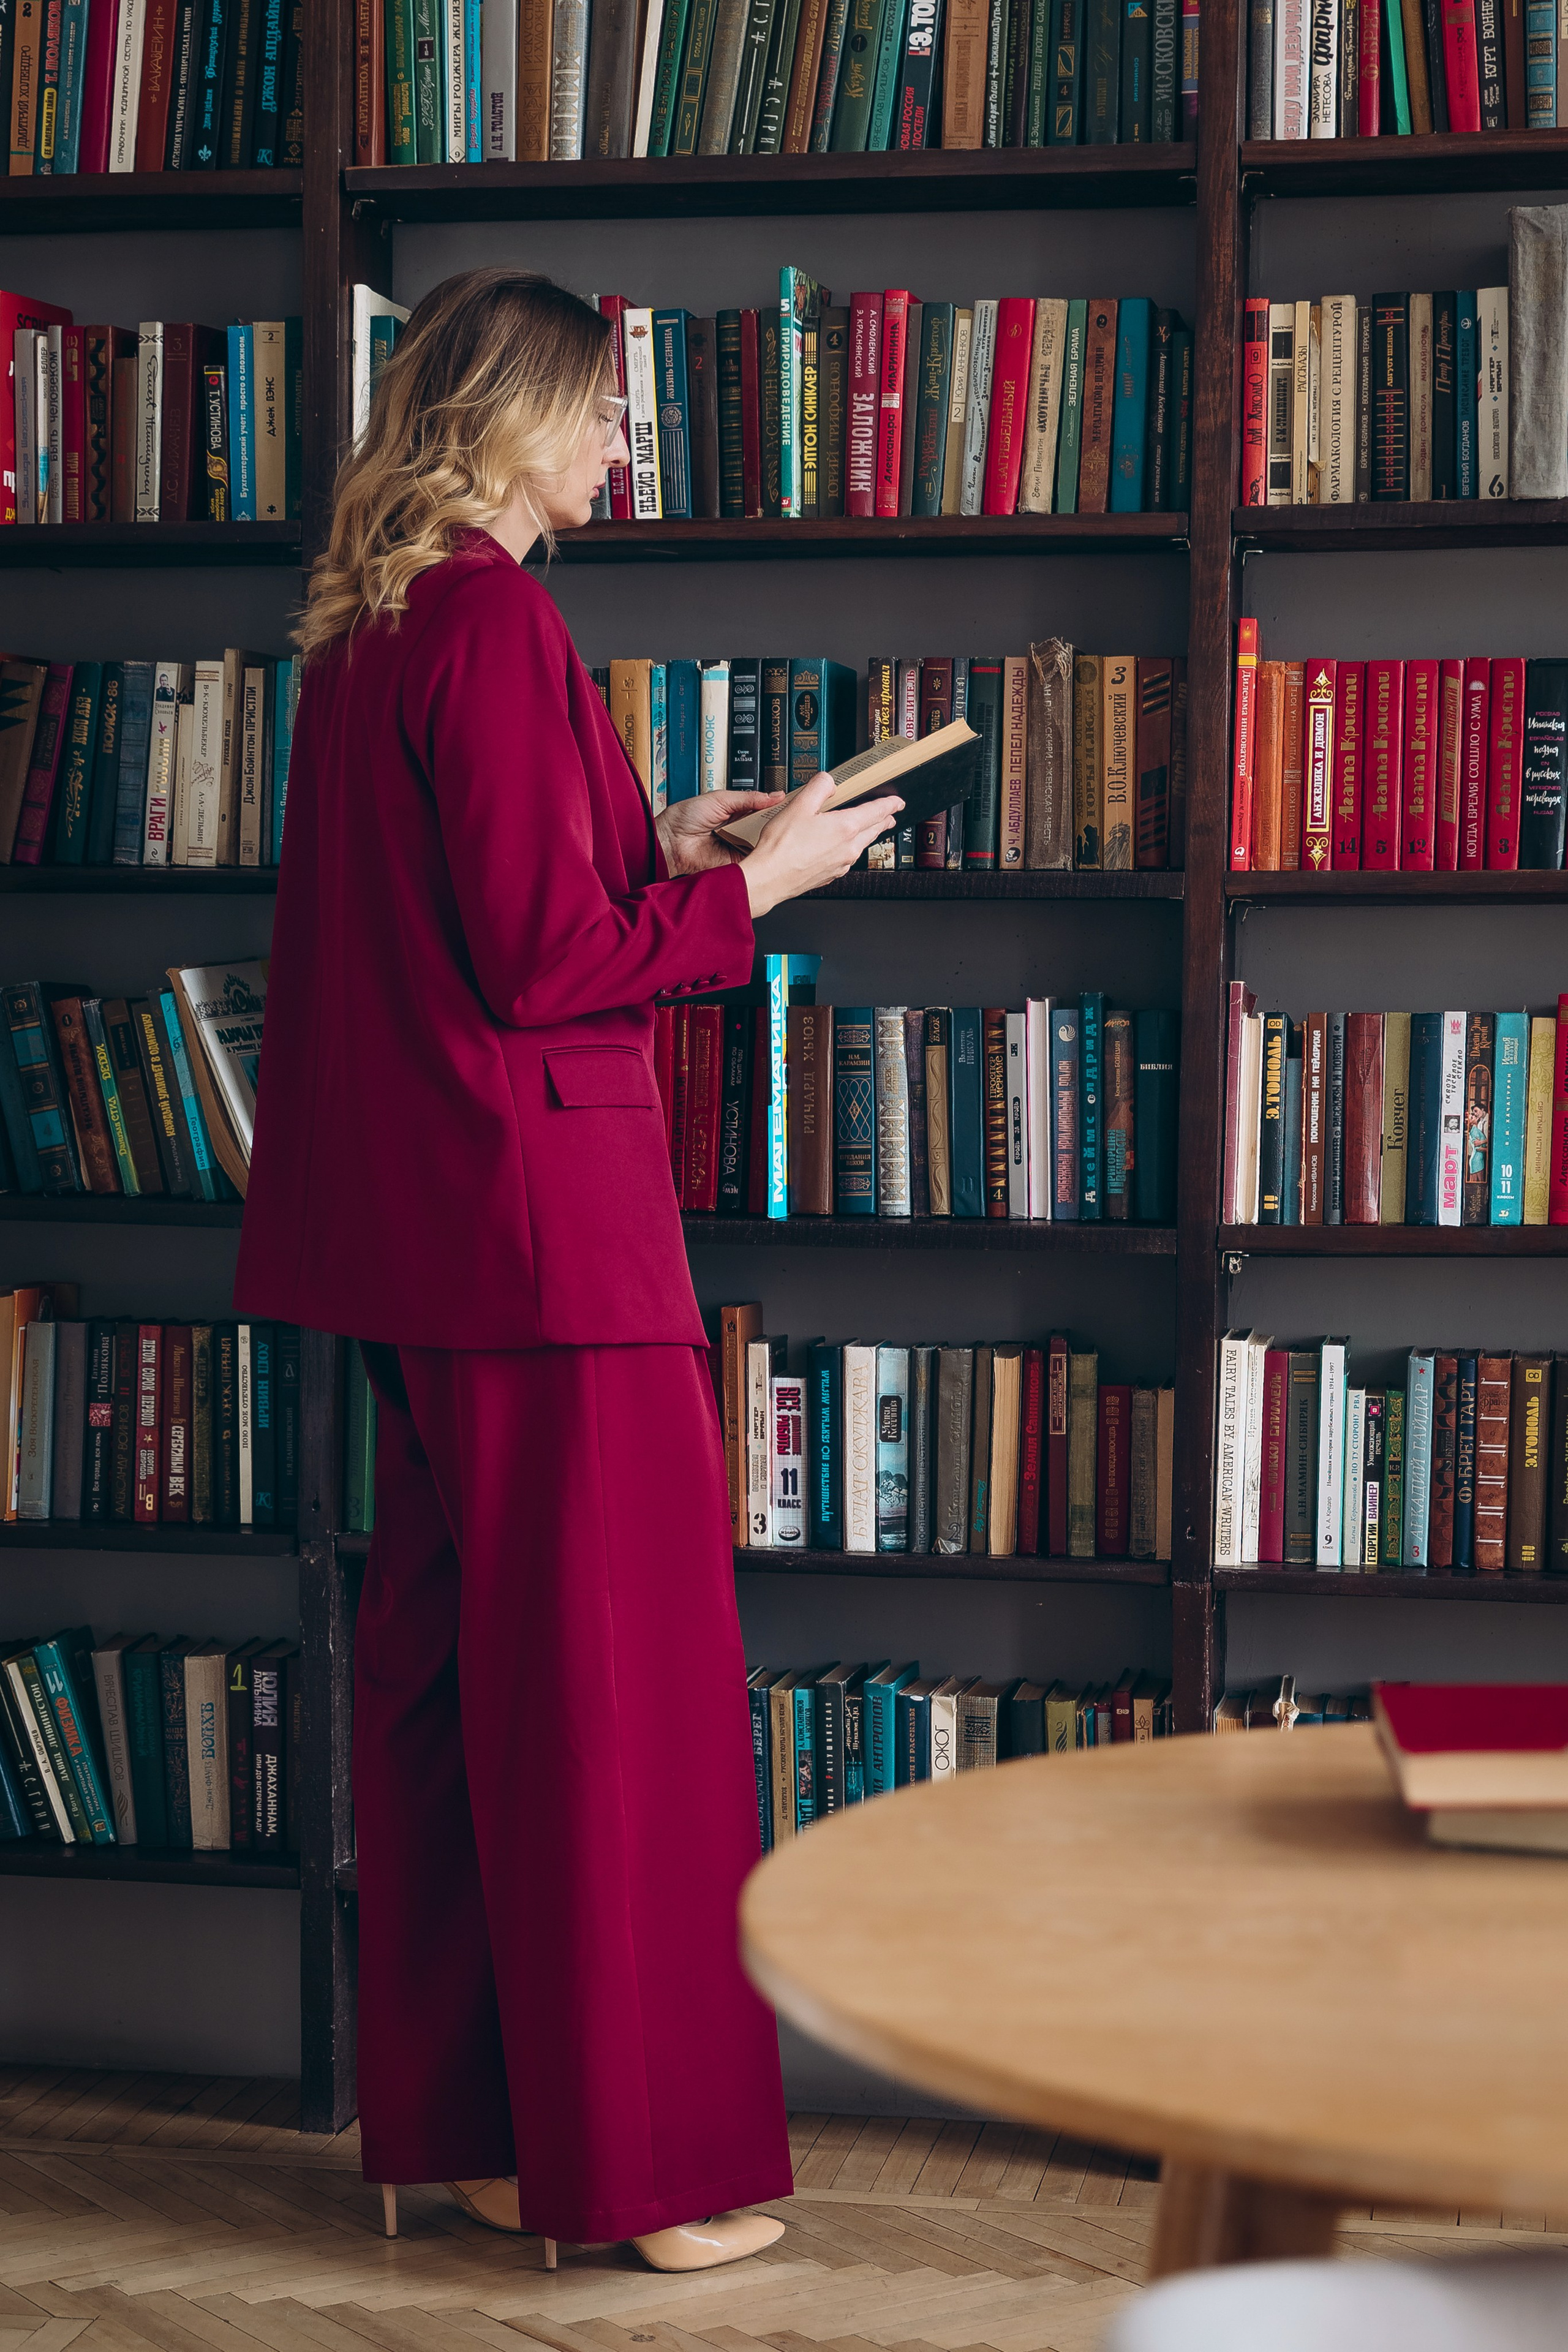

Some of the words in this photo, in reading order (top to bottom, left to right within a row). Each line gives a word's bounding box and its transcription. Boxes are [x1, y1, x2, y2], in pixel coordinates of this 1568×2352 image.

[23, 2, 31, 17] 2
[693, 32, 703, 58] БОГДАН
[1035, 26, 1044, 58] ПРОТИВ
[20, 45, 33, 98] ХОЛЕНДРО
[120, 66, 130, 115] МЕДИЦИНСКОЙ
[126, 20, 132, 30] ПО
[261, 66, 277, 112] ДЖОН
[453, 44, 462, 99] РОДЖЕРА
[1033, 61, 1043, 91] ГЕРЦЕН
[45, 92, 54, 110] ТАЙНА
[359, 63, 369, 134] ГАРГАНТЮА
[490, 92, 503, 132] ТОЛСТОЙ
[1031, 96, 1041, 137] Эйдельман
[1312, 75, 1321, 123] ЭЛЬМИРА
[1323, 72, 1332, 123] НЕТЕСОВА
[17, 101, 29, 148] ДМИТРИЙ
[44, 111, 53, 147] МАЛЕНЬКАЯ
[491, 134, 503, 151] Л.Н.
[268, 332, 274, 341] 2
[664, 327, 673, 368] ЕСЕНИНА
[854, 318, 864, 378] КРАСНЯНСКИЙ
[867, 319, 876, 375] СМОЛЕНСКИЙ
[1070, 327, 1080, 360] БРАМА
[1330, 301, 1344, 385] РЕЦЕПТУРОЙ
[49, 351, 58, 423] человеком
[145, 355, 158, 410] Ernest
[238, 382, 247, 410] просто
[265, 377, 274, 402] ВЭНС
[665, 369, 675, 400] ЖИЗНЬ
[781, 326, 791, 445] ПРИРОДОВЕДЕНИЕ
[804, 366, 818, 421] СИНКЛЕР
[1068, 363, 1078, 407] ЗЕЛЕНАЯ
[211, 398, 222, 449] УСТИНОВА
[266, 406, 276, 437] Джек
[635, 421, 654, 464] МАРШ
[849, 392, 875, 492] ЗАЛОЖНИК
[50, 429, 58, 462] БЫТЬ
[138, 414, 156, 496] Hemingway
[239, 436, 249, 498] Бухгалтерский
[804, 425, 818, 469] ЭПТОН
[1330, 399, 1341, 501] ФАРМАКОЛОГИЯ
[635, 471, 656, 513] НЬЕЙО
[107, 680, 118, 697] 86
[881, 665, 891, 706] правил
[1110, 666, 1126, 684] 3
[244, 686, 256, 731] ПРИСТЛИ
[877, 707, 890, 725] без
[1011, 666, 1025, 731] НАДЕЖДЫ
[1341, 673, 1360, 751] Кристи
[1471, 695, 1482, 719] УМА
[102, 703, 117, 754] ПОИСК
[704, 715, 715, 764] СИМОНС
[1316, 713, 1325, 749] ДЕМОН
[1470, 722, 1481, 731] С
[244, 733, 255, 775] Бойнтон
[1009, 733, 1023, 774] ПЕПЕЛ
[1469, 734, 1480, 778] СОШЛО
[243, 777, 255, 804] Джон
[1008, 778, 1023, 834] АБДУЛЛАЕВ
[1313, 761, 1324, 818] АНЖЕЛИКА
[1338, 755, 1355, 823] Агата
[1468, 782, 1479, 818] ВРЕМЯ
[148, 797, 166, 841] ВРАГИ
[1008, 835, 1020, 845] Ч.
[1466, 822, 1478, 858] КОГДА
[1338, 837, 1357, 854] 14
[141, 1013, 159, 1055] ОДИНОЧКУ
[803, 1016, 814, 1061] ХЬЮЗ
[932, 1016, 941, 1042] БЛОК
[96, 1043, 111, 1080] ДЕДДИ
[1311, 1030, 1321, 1074] ГЕЙДРИХА
[151, 1064, 169, 1099] УМИРАЕТ
[772, 974, 784, 1203] МАТЕМАТИКА
[1265, 1035, 1282, 1120] Э.ТОПОЛЬ
[1311, 1076, 1320, 1088] НА
[108, 1096, 120, 1121] СТИЛ
[158, 1100, 176, 1137] КАЖДЫЙ
[804, 1071, 815, 1134] РИЧАРД
[1310, 1091, 1321, 1144] ПОКУШЕНИЕ
[723, 1100, 740, 1175] УСТИНОВА
[1442, 1144, 1457, 1208] март
[141, 1339, 156, 1363] ЛЕТОМ
[257, 1341, 270, 1374] ШОУ
[1226, 1349, 1237, 1382] FAIRY
[141, 1367, 156, 1390] СОРОК
[141, 1395, 156, 1426] ПЕРВОГО
[258, 1380, 270, 1428] ИРВИН
[851, 1362, 871, 1471] ОКУДЖАВА
[1224, 1385, 1235, 1420] TALES
[1412, 1383, 1428, 1451] ГАЙДАР
[1223, 1424, 1235, 1439] BY
[780, 1468, 799, 1495] 11
[1221, 1442, 1234, 1501] AMERICAN
[777, 1499, 801, 1509] КЛАСС
[852, 1472, 869, 1538] БУЛАТ
[1410, 1457, 1426, 1542] АРКАДИЙ
[1220, 1507, 1232, 1556] WRITERS
[31, 1683, 58, 1748] ЛИВИНГСТОН
[103, 1674, 118, 1725] ВЯЧЕСЛАВ
[254, 1669, 262, 1727] ЛАТЫНИНА
[262, 1671, 277, 1727] ЮЛИЯ
[200, 1702, 215, 1760] ВОЛХВ
[753, 1713, 763, 1756] БЕРЕГ
[934, 1725, 950, 1771] ОЖОГ
[55, 1752, 70, 1781] ДАВИД
[110, 1728, 124, 1781] ШИШКОВ
[203, 1761, 213, 1787] ФАУЛЗ
[265, 1754, 277, 1837] ДЖАХАННАМ,
